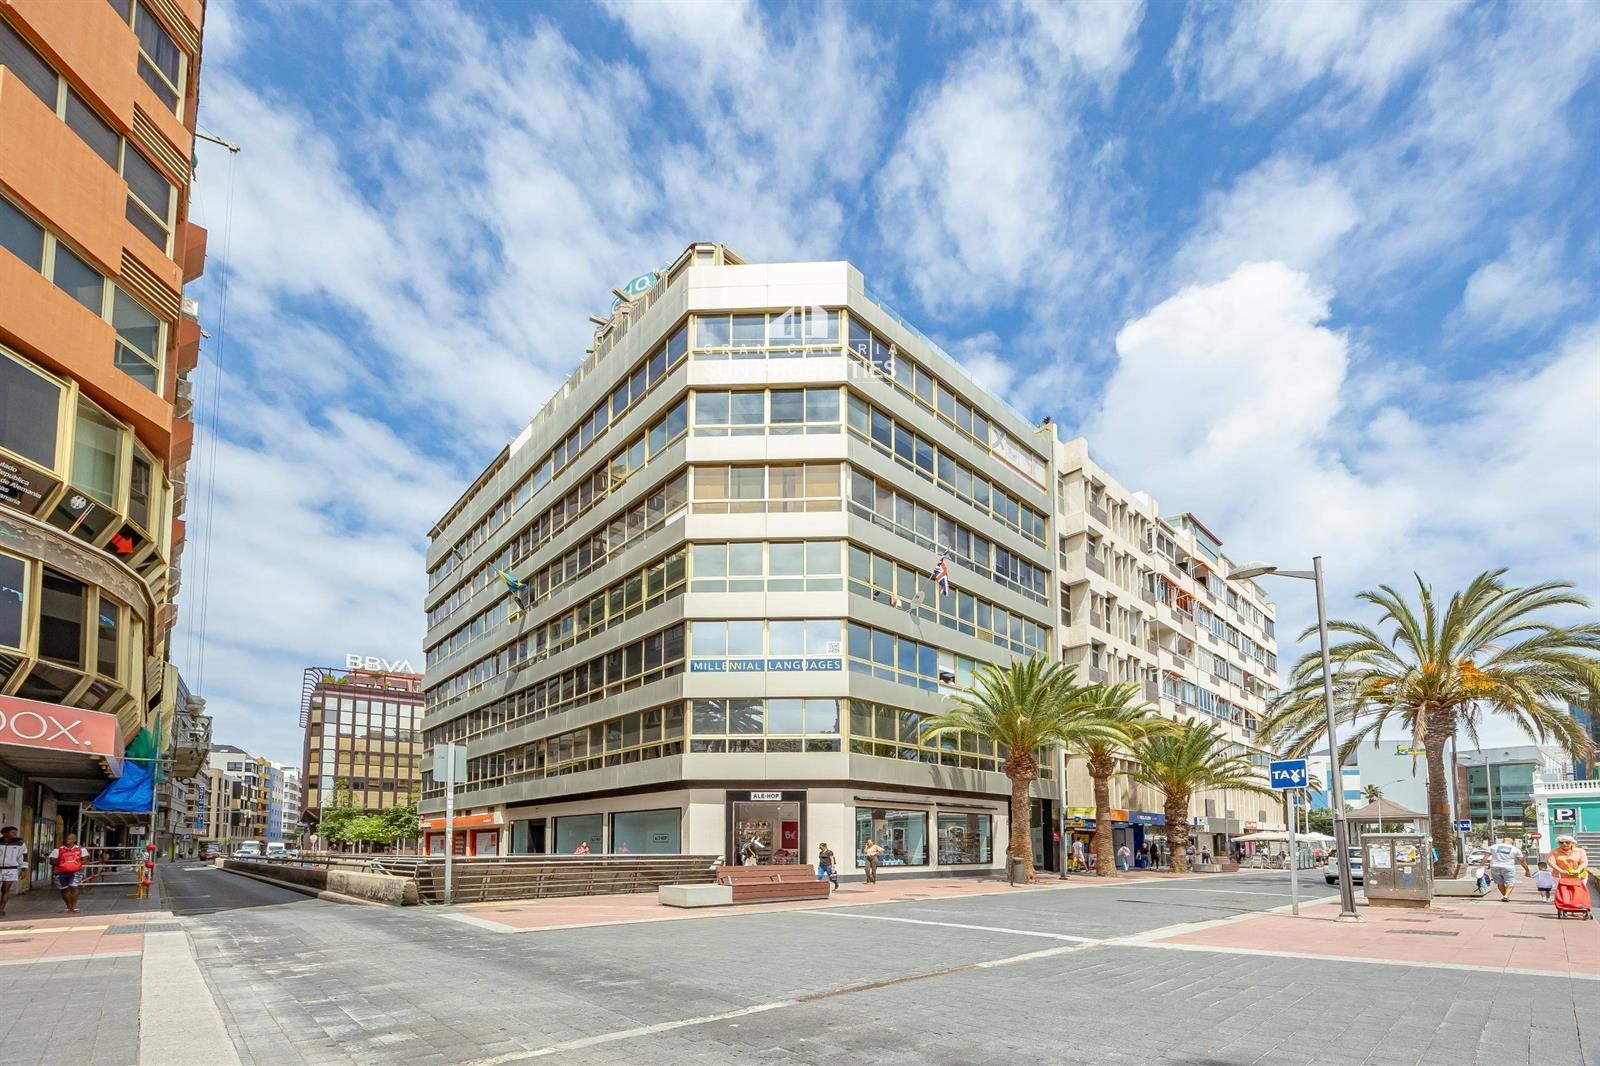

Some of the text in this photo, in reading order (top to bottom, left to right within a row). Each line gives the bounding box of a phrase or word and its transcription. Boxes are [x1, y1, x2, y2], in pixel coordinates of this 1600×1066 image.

[10, 482, 42, 499] Alemania
[346, 653, 416, 674] BBVA
[694, 660, 841, 671] MILLENNIAL LANGUAGES
[0, 710, 92, 746] OX.
[1272, 769, 1305, 780] TAXI
